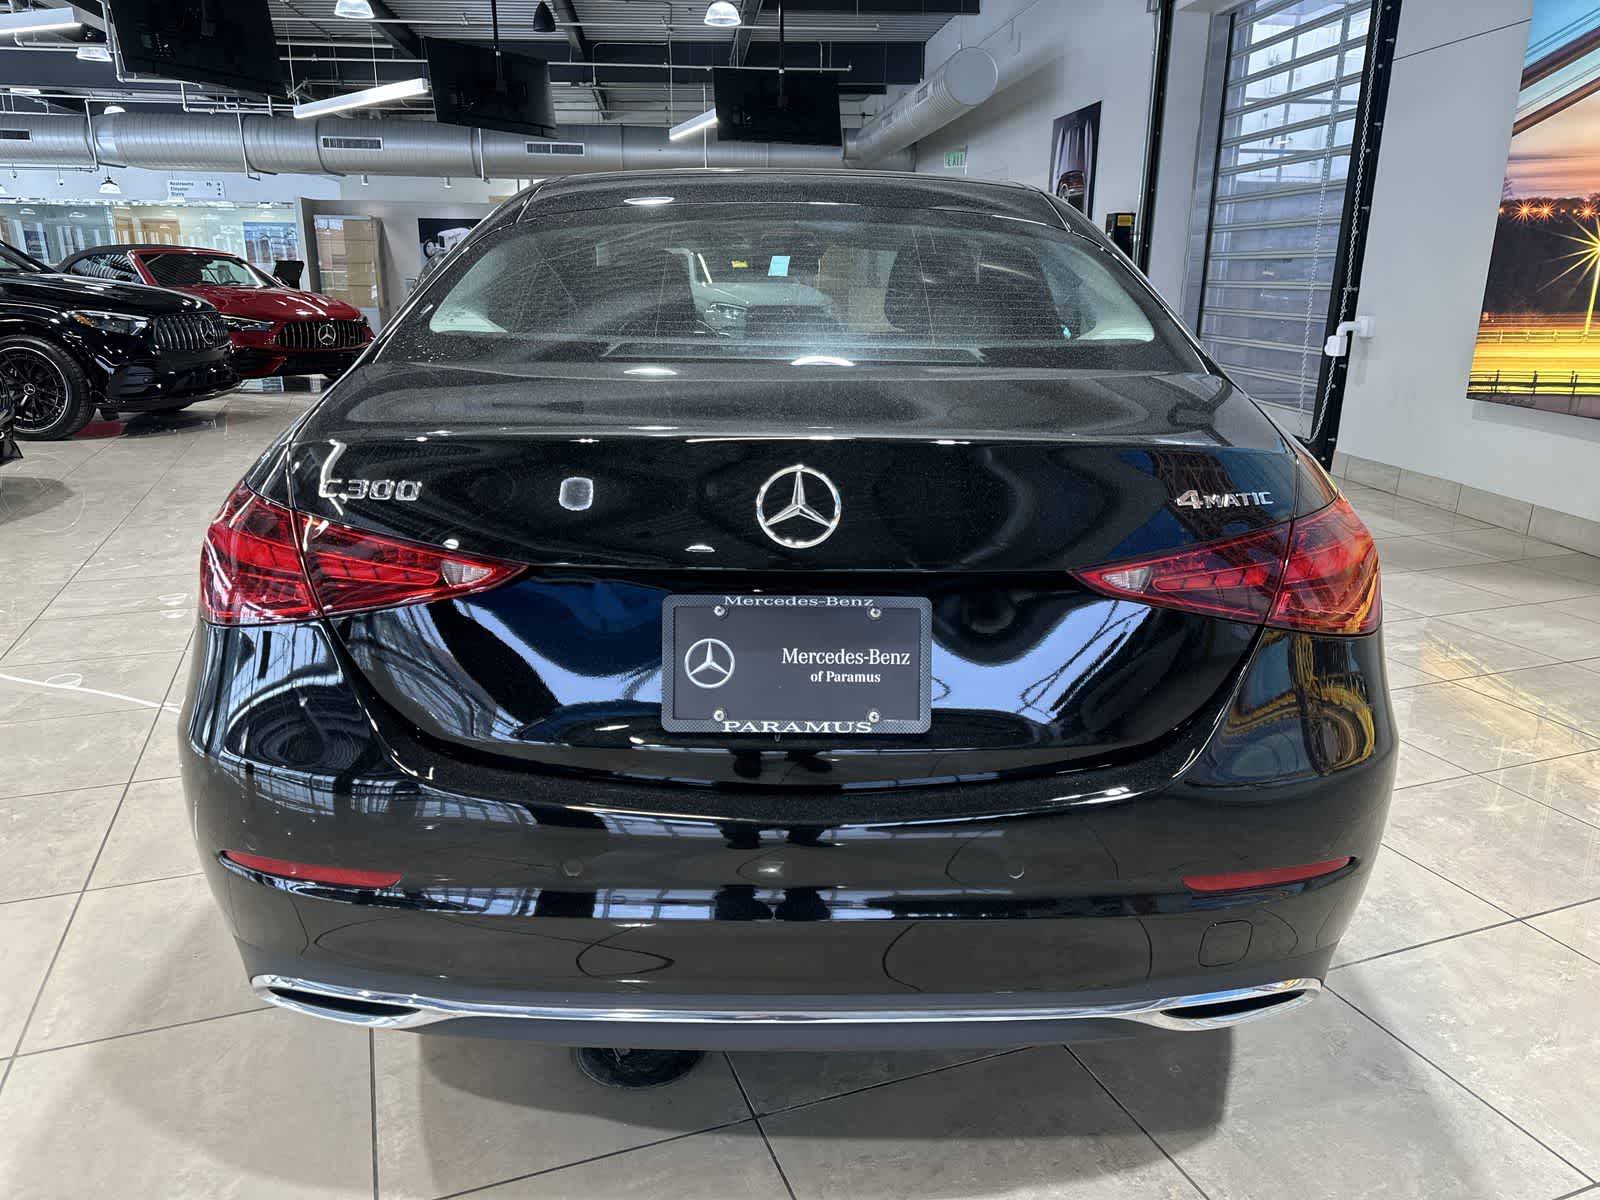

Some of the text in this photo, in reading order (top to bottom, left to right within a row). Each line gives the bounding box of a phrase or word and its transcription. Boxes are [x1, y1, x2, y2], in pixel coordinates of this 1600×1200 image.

[1175, 489, 1274, 510] 4MATIC
[724, 595, 875, 608] Mercedes-Benz
[782, 647, 911, 665] Mercedes-Benz
[810, 670, 881, 683] of Paramus
[722, 721, 874, 734] PARAMUS
